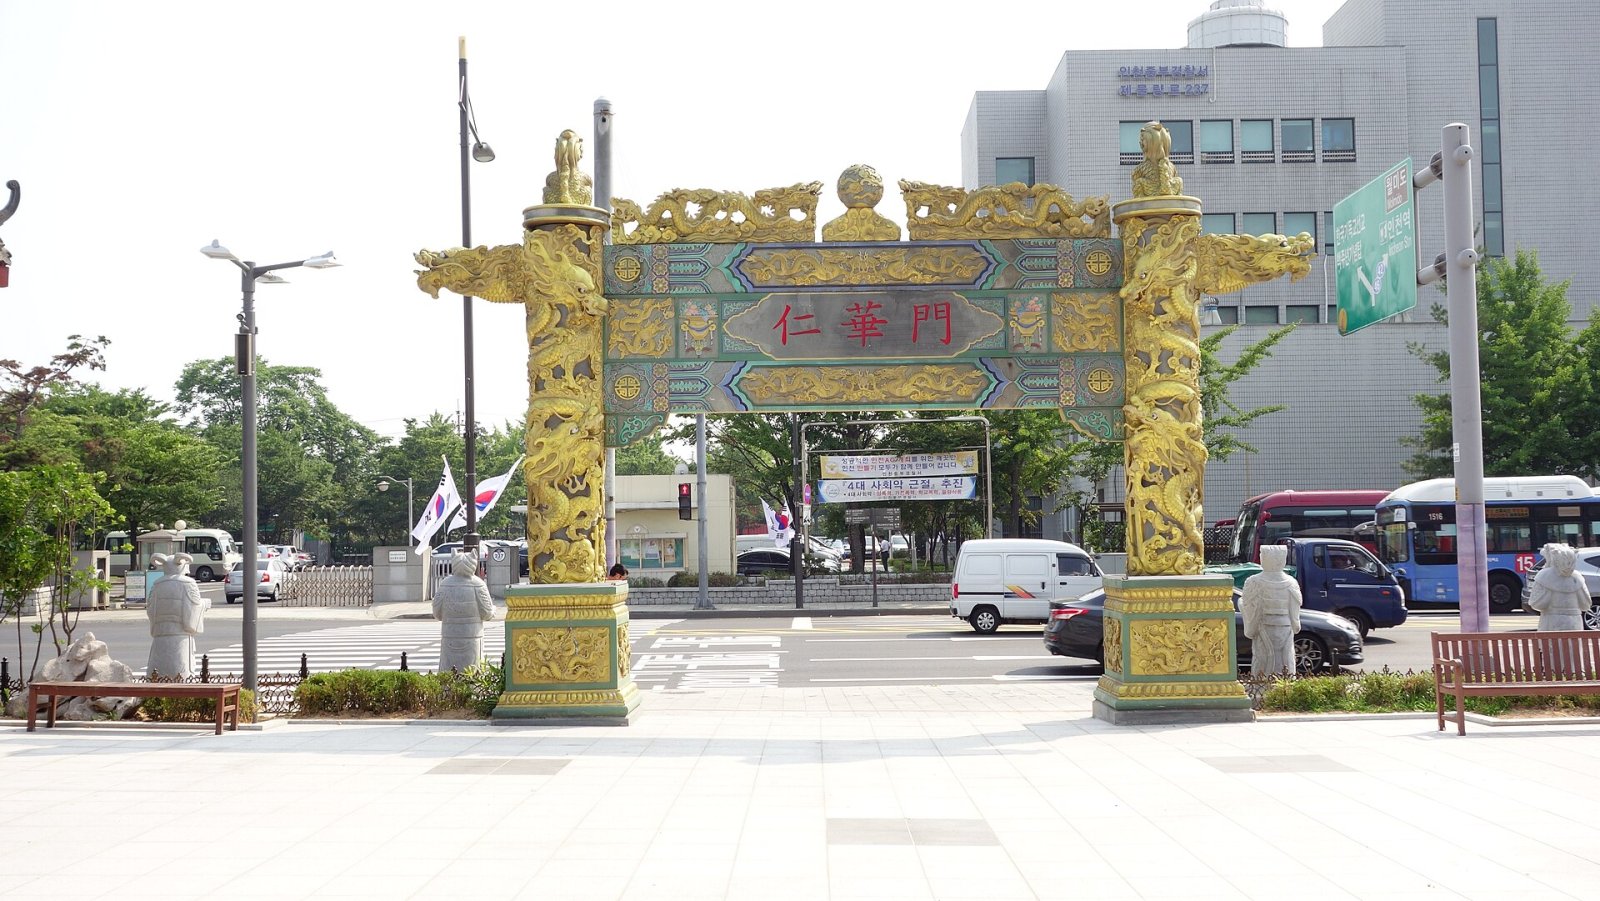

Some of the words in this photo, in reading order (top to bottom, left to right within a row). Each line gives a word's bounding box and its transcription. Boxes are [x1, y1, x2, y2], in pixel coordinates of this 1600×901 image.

[1119, 65, 1208, 78] 인천중부경찰서
[1120, 84, 1181, 97] 제물량로
[1185, 83, 1209, 96] 237
[1386, 168, 1407, 196] 월미도
[870, 479, 904, 490] 사회악
[940, 478, 964, 489] 추진
[1428, 512, 1443, 521] 1516
[1516, 556, 1534, 572] 15
